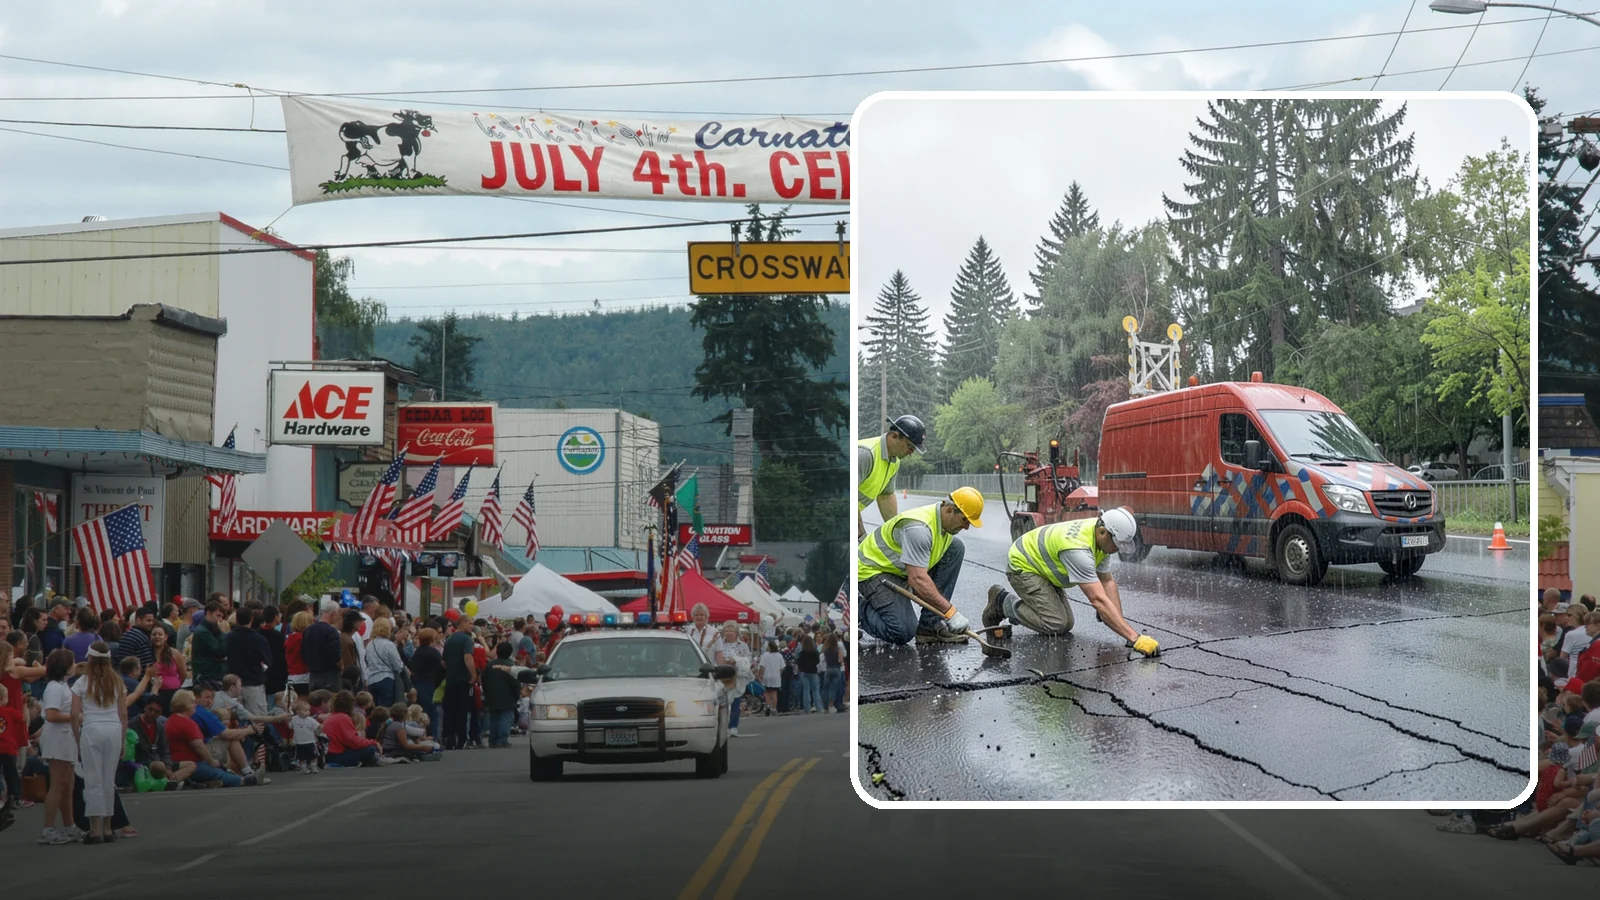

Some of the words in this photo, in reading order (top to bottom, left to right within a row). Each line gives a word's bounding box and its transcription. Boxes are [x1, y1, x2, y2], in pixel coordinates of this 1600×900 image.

[481, 141, 604, 192] JULY
[632, 150, 746, 197] 4th.
[697, 254, 850, 279] CROSSWA
[283, 380, 373, 420] ACE
[405, 409, 452, 422] CEDAR
[283, 421, 370, 436] Hardware
[416, 428, 477, 446] Coca-Cola
[353, 467, 385, 479] Simpl
[95, 485, 124, 495] Vincent
[126, 486, 135, 495] de
[137, 486, 155, 495] Paul
[688, 526, 741, 535] CRNATION
[699, 535, 730, 543] GLASS
